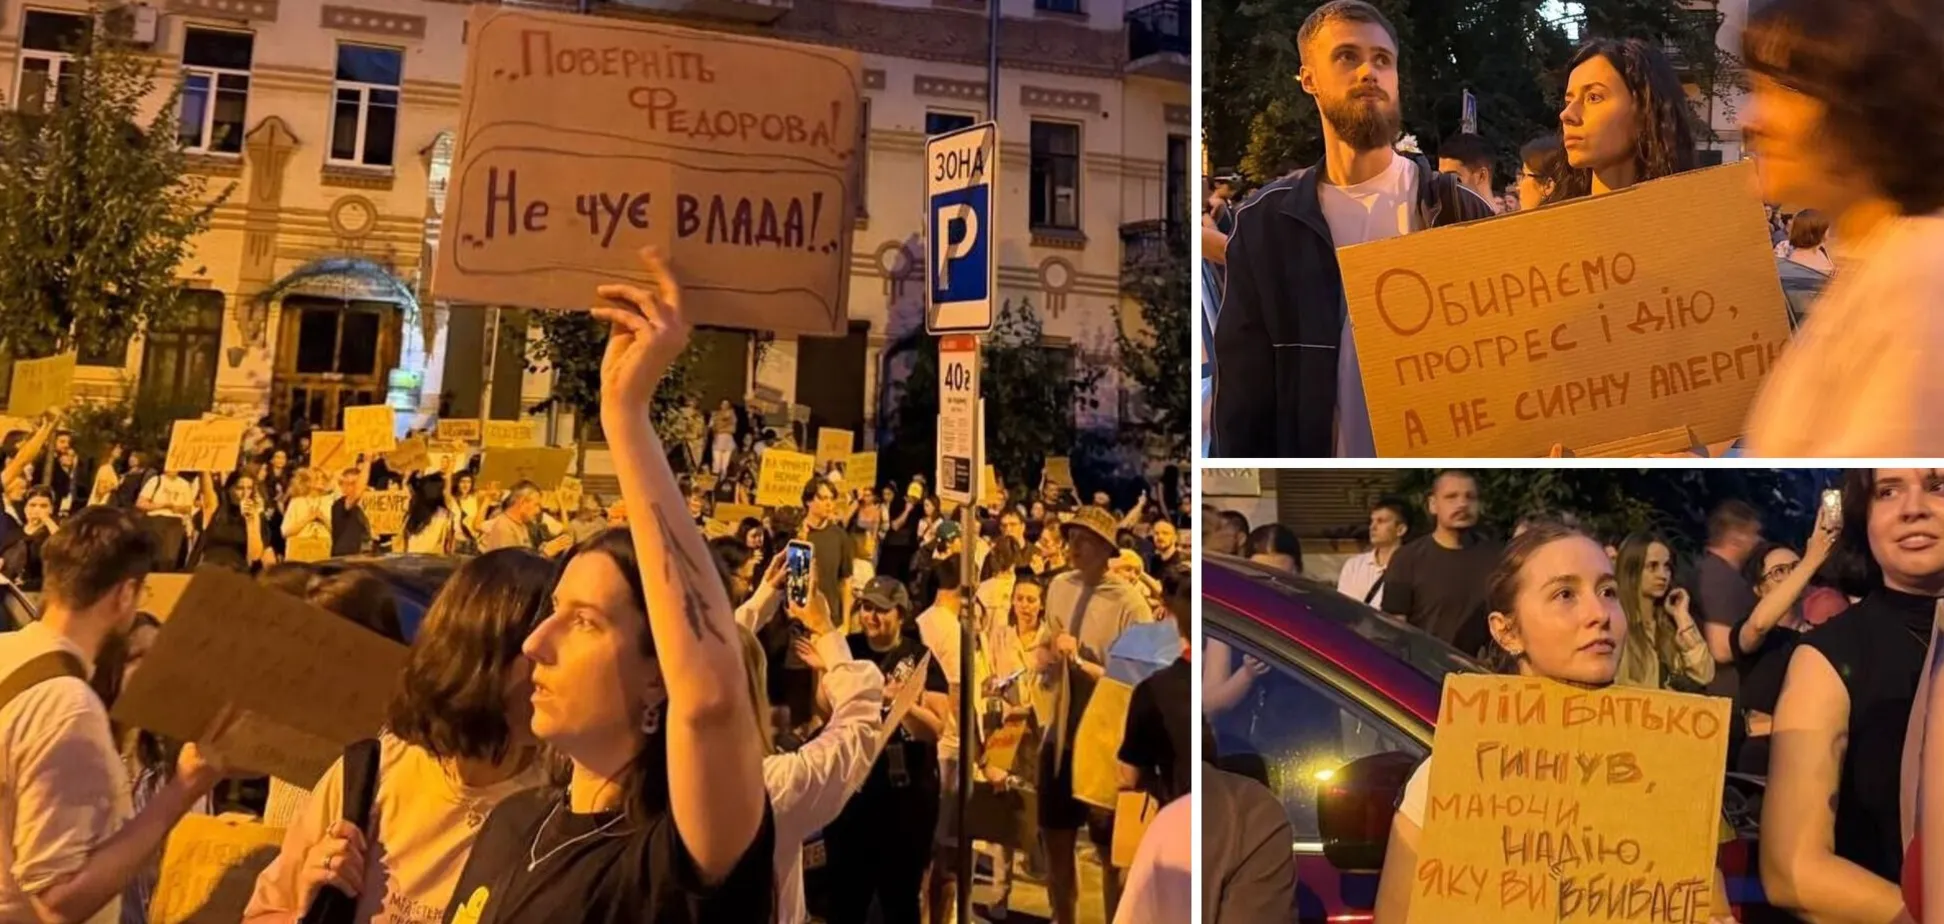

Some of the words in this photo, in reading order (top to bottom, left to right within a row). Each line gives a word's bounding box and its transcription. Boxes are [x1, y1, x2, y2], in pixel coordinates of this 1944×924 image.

[934, 149, 984, 183] ЗОНА
[937, 204, 979, 291] P
[1445, 684, 1547, 726] МІЙ
[1562, 693, 1720, 740] БАТЬКО
[1475, 740, 1657, 794] ГИНУВ,
[1431, 793, 1580, 826] МАЮЧИ
[1502, 826, 1655, 873] НАДІЮ,
[1417, 858, 1489, 900] ЯКУ
[1499, 868, 1548, 910] ВИ
